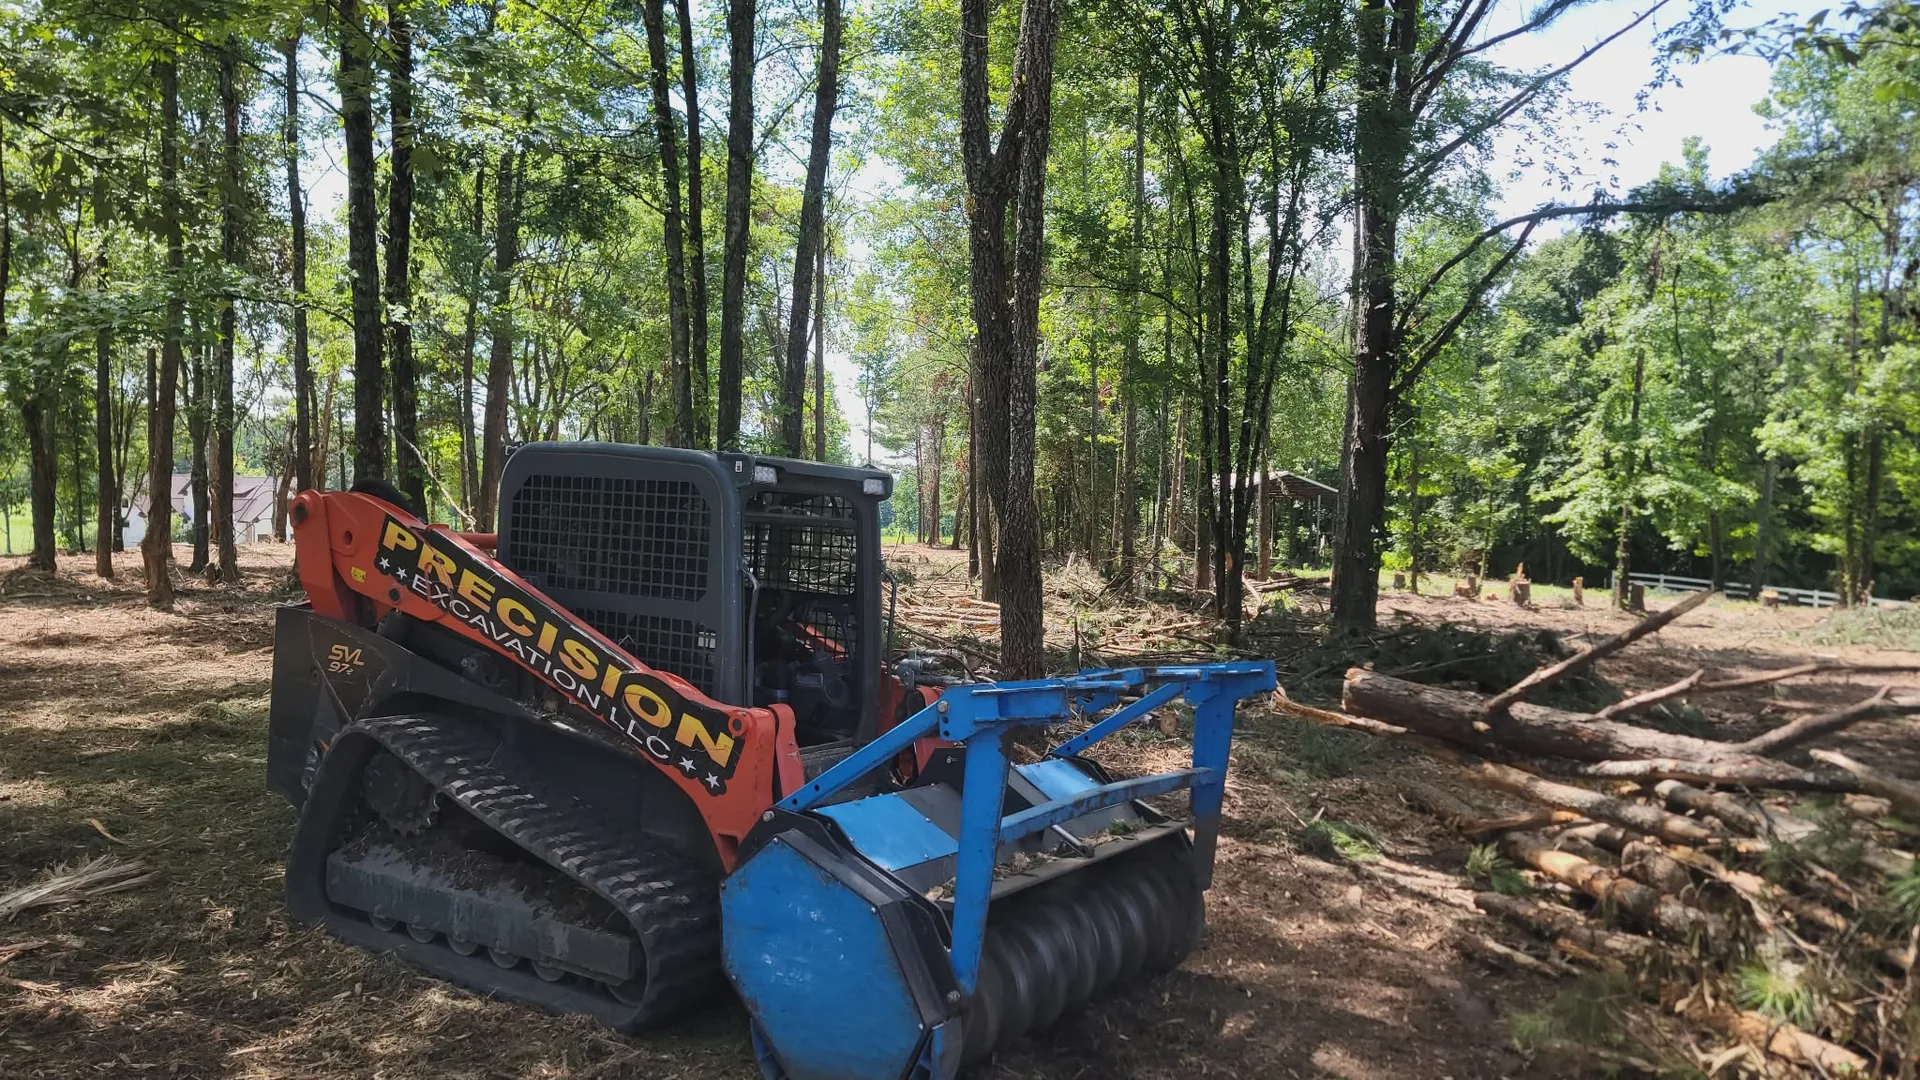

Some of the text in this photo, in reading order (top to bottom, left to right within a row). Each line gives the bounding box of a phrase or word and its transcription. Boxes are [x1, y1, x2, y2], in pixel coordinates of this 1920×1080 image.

[327, 644, 365, 666] SVL
[382, 520, 735, 768] PRECISION
[411, 573, 670, 760] EXCAVATION LLC
